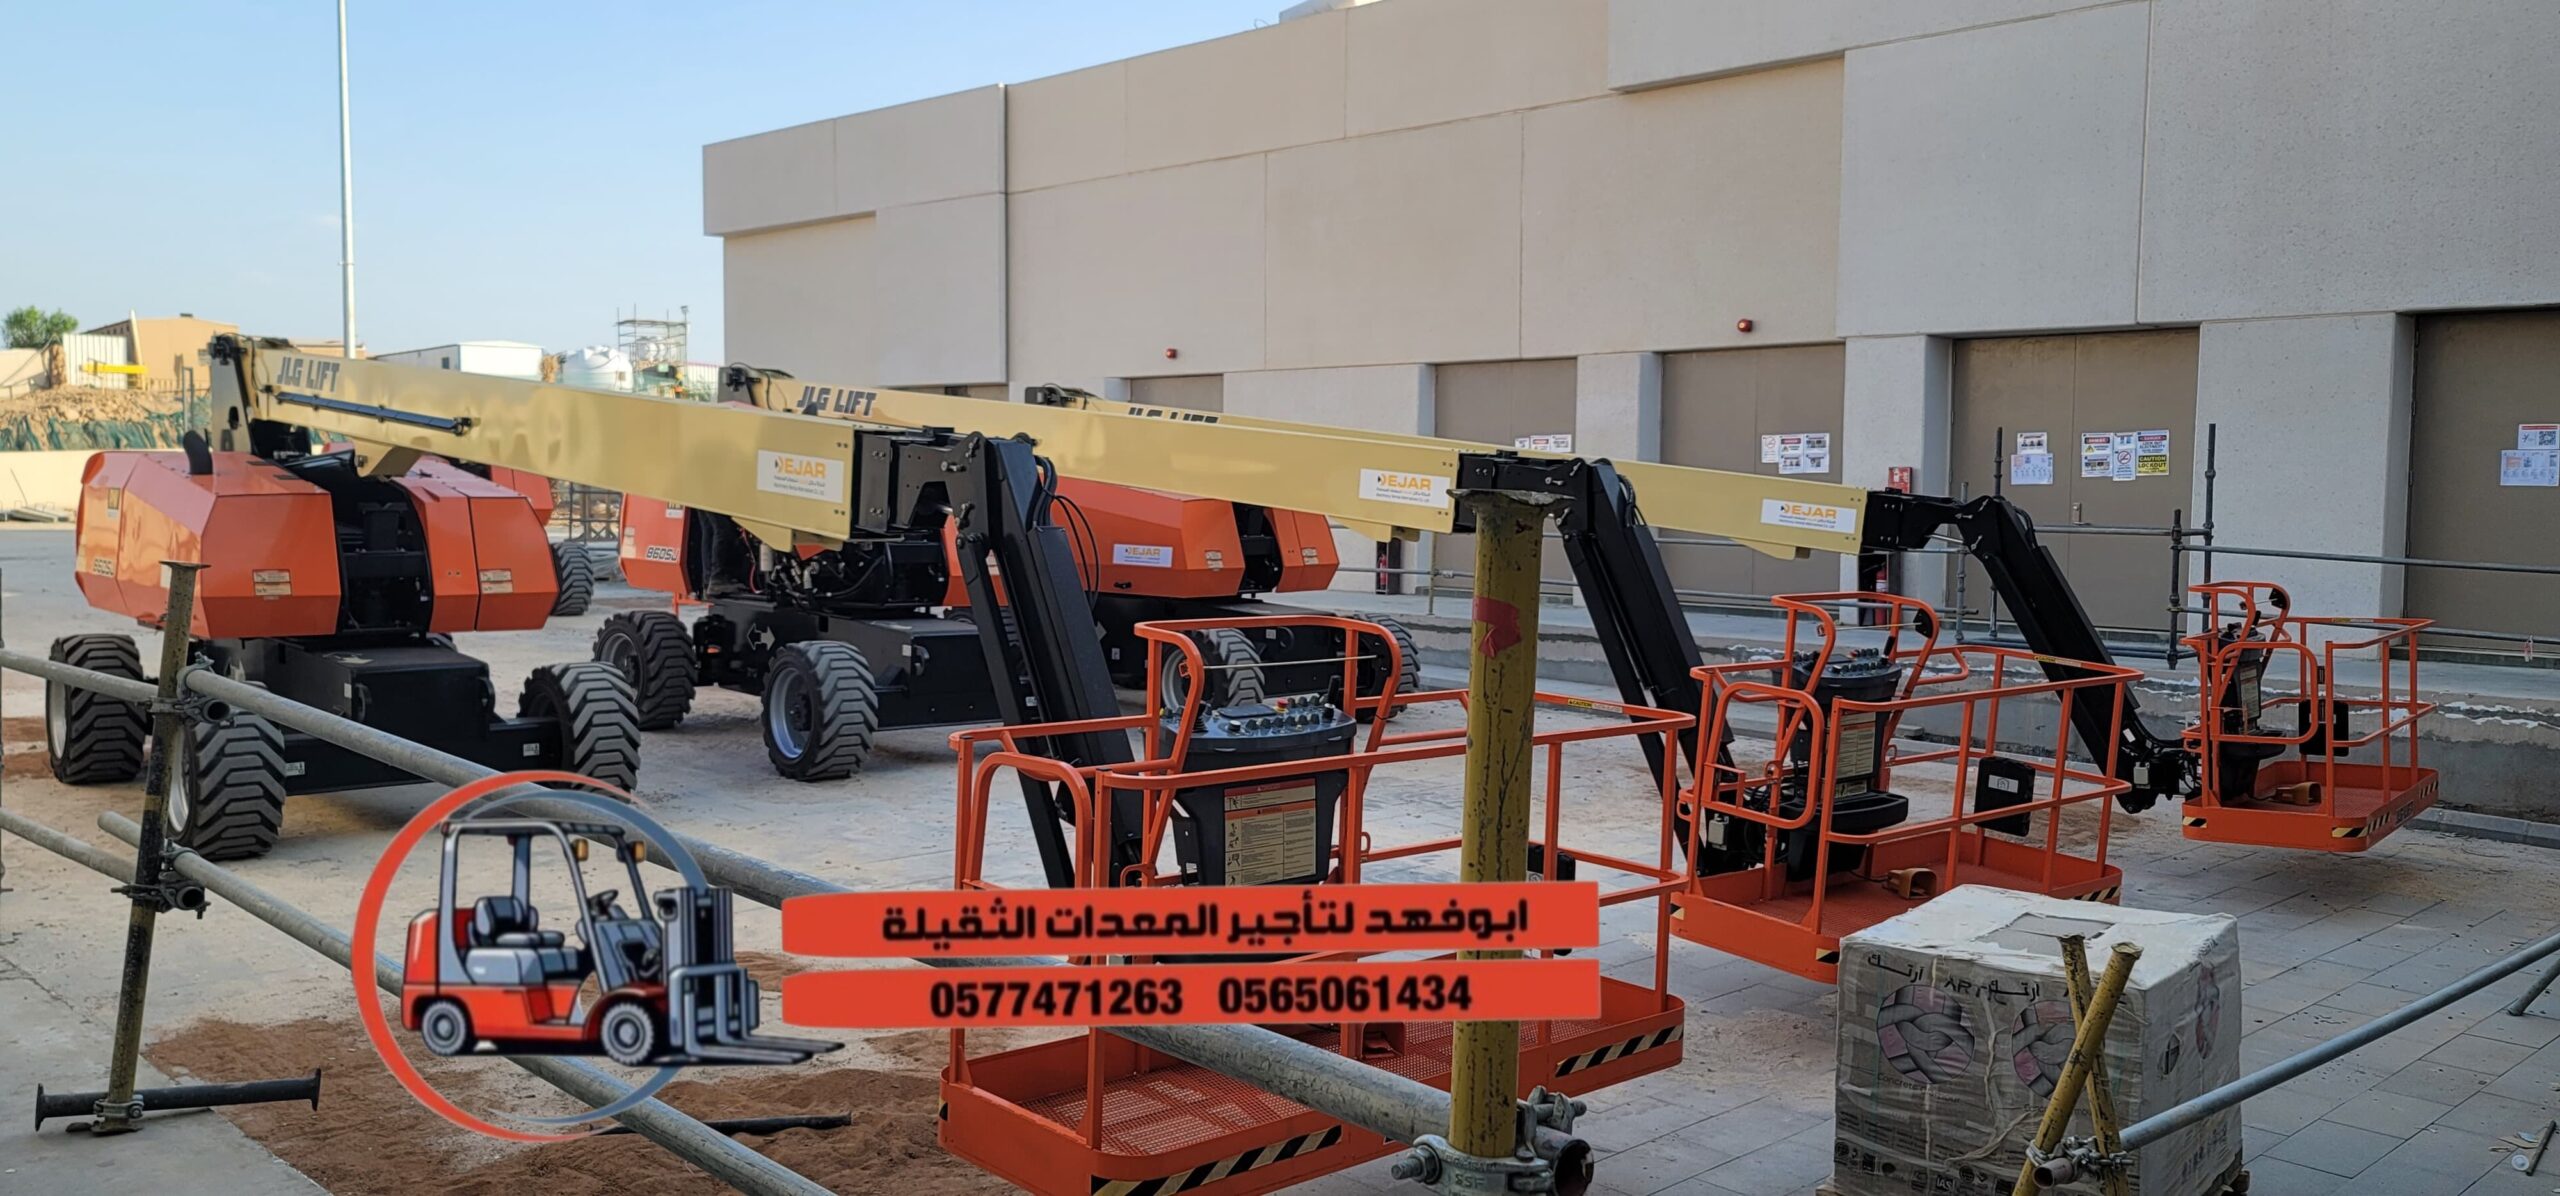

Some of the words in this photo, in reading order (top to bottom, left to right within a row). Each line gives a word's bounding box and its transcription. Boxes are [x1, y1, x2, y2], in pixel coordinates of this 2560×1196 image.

[277, 356, 304, 387] JLG
[305, 359, 340, 392] LIFT
[797, 385, 831, 411] JLG
[833, 389, 877, 416] LIFT
